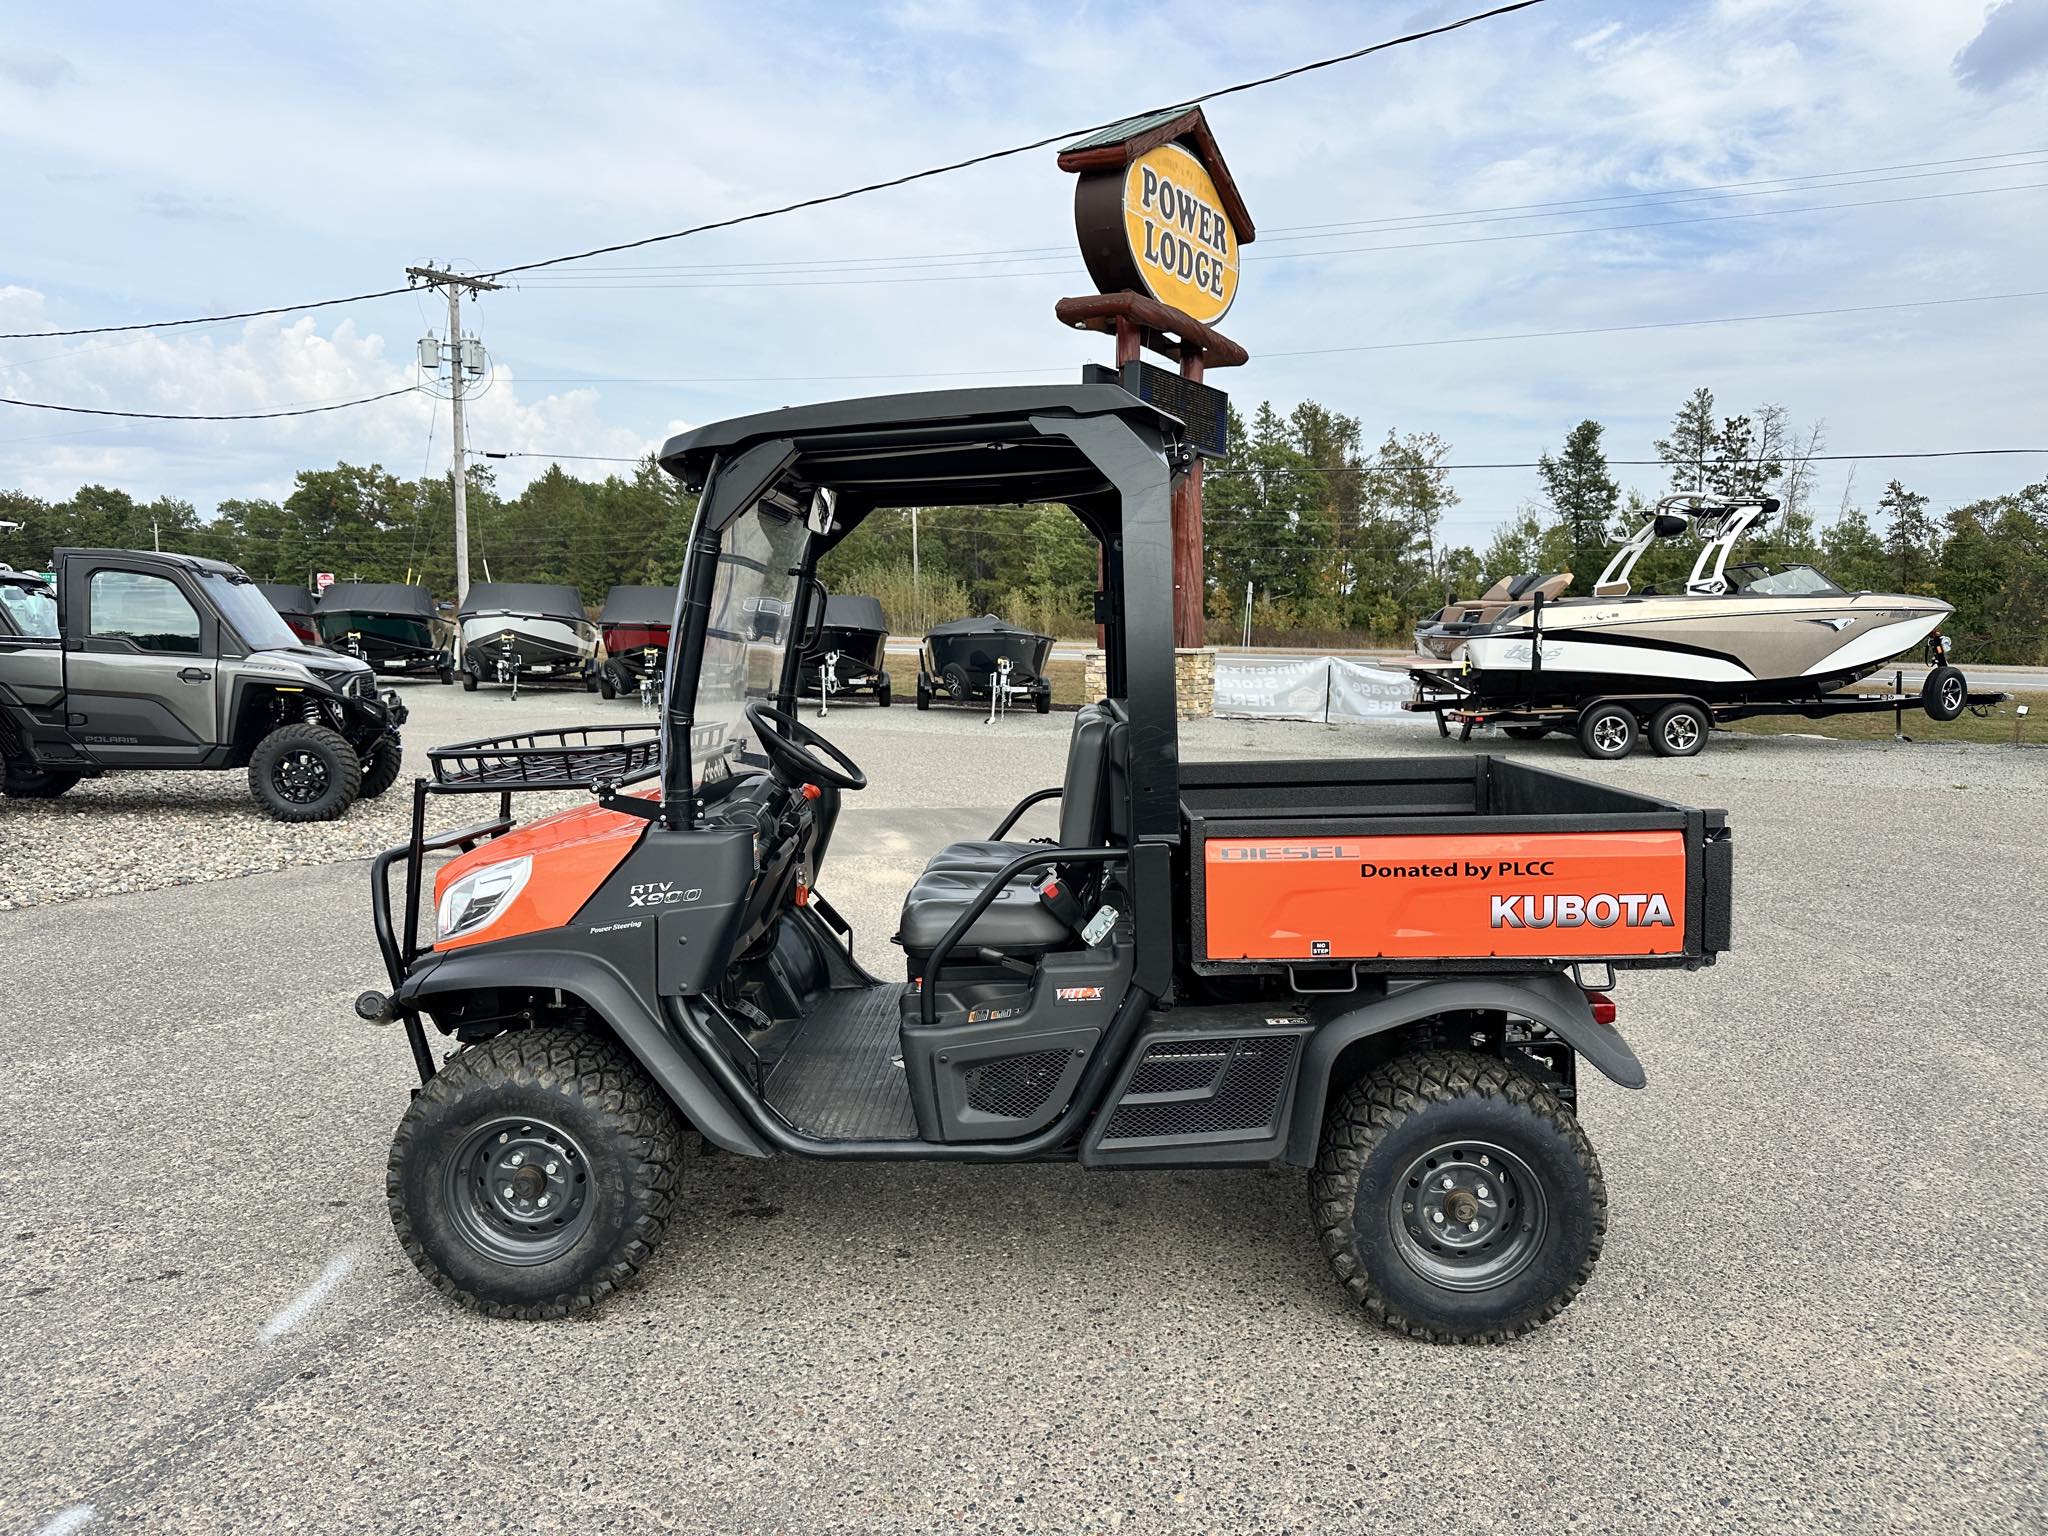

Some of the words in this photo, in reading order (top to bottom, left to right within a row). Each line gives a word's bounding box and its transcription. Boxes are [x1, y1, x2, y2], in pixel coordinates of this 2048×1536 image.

[1142, 166, 1227, 255] POWER
[1144, 220, 1224, 298] LODGE
[85, 736, 139, 744] POLARIS
[1221, 846, 1360, 861] DIESEL
[1360, 861, 1458, 878] Donated
[1464, 861, 1493, 881] by
[1498, 861, 1555, 876] PLCC
[627, 888, 703, 908] X900
[630, 881, 674, 895] RTV
[1490, 893, 1676, 930] KUBOTA
[589, 926, 613, 935] Power
[612, 920, 643, 931] Steering
